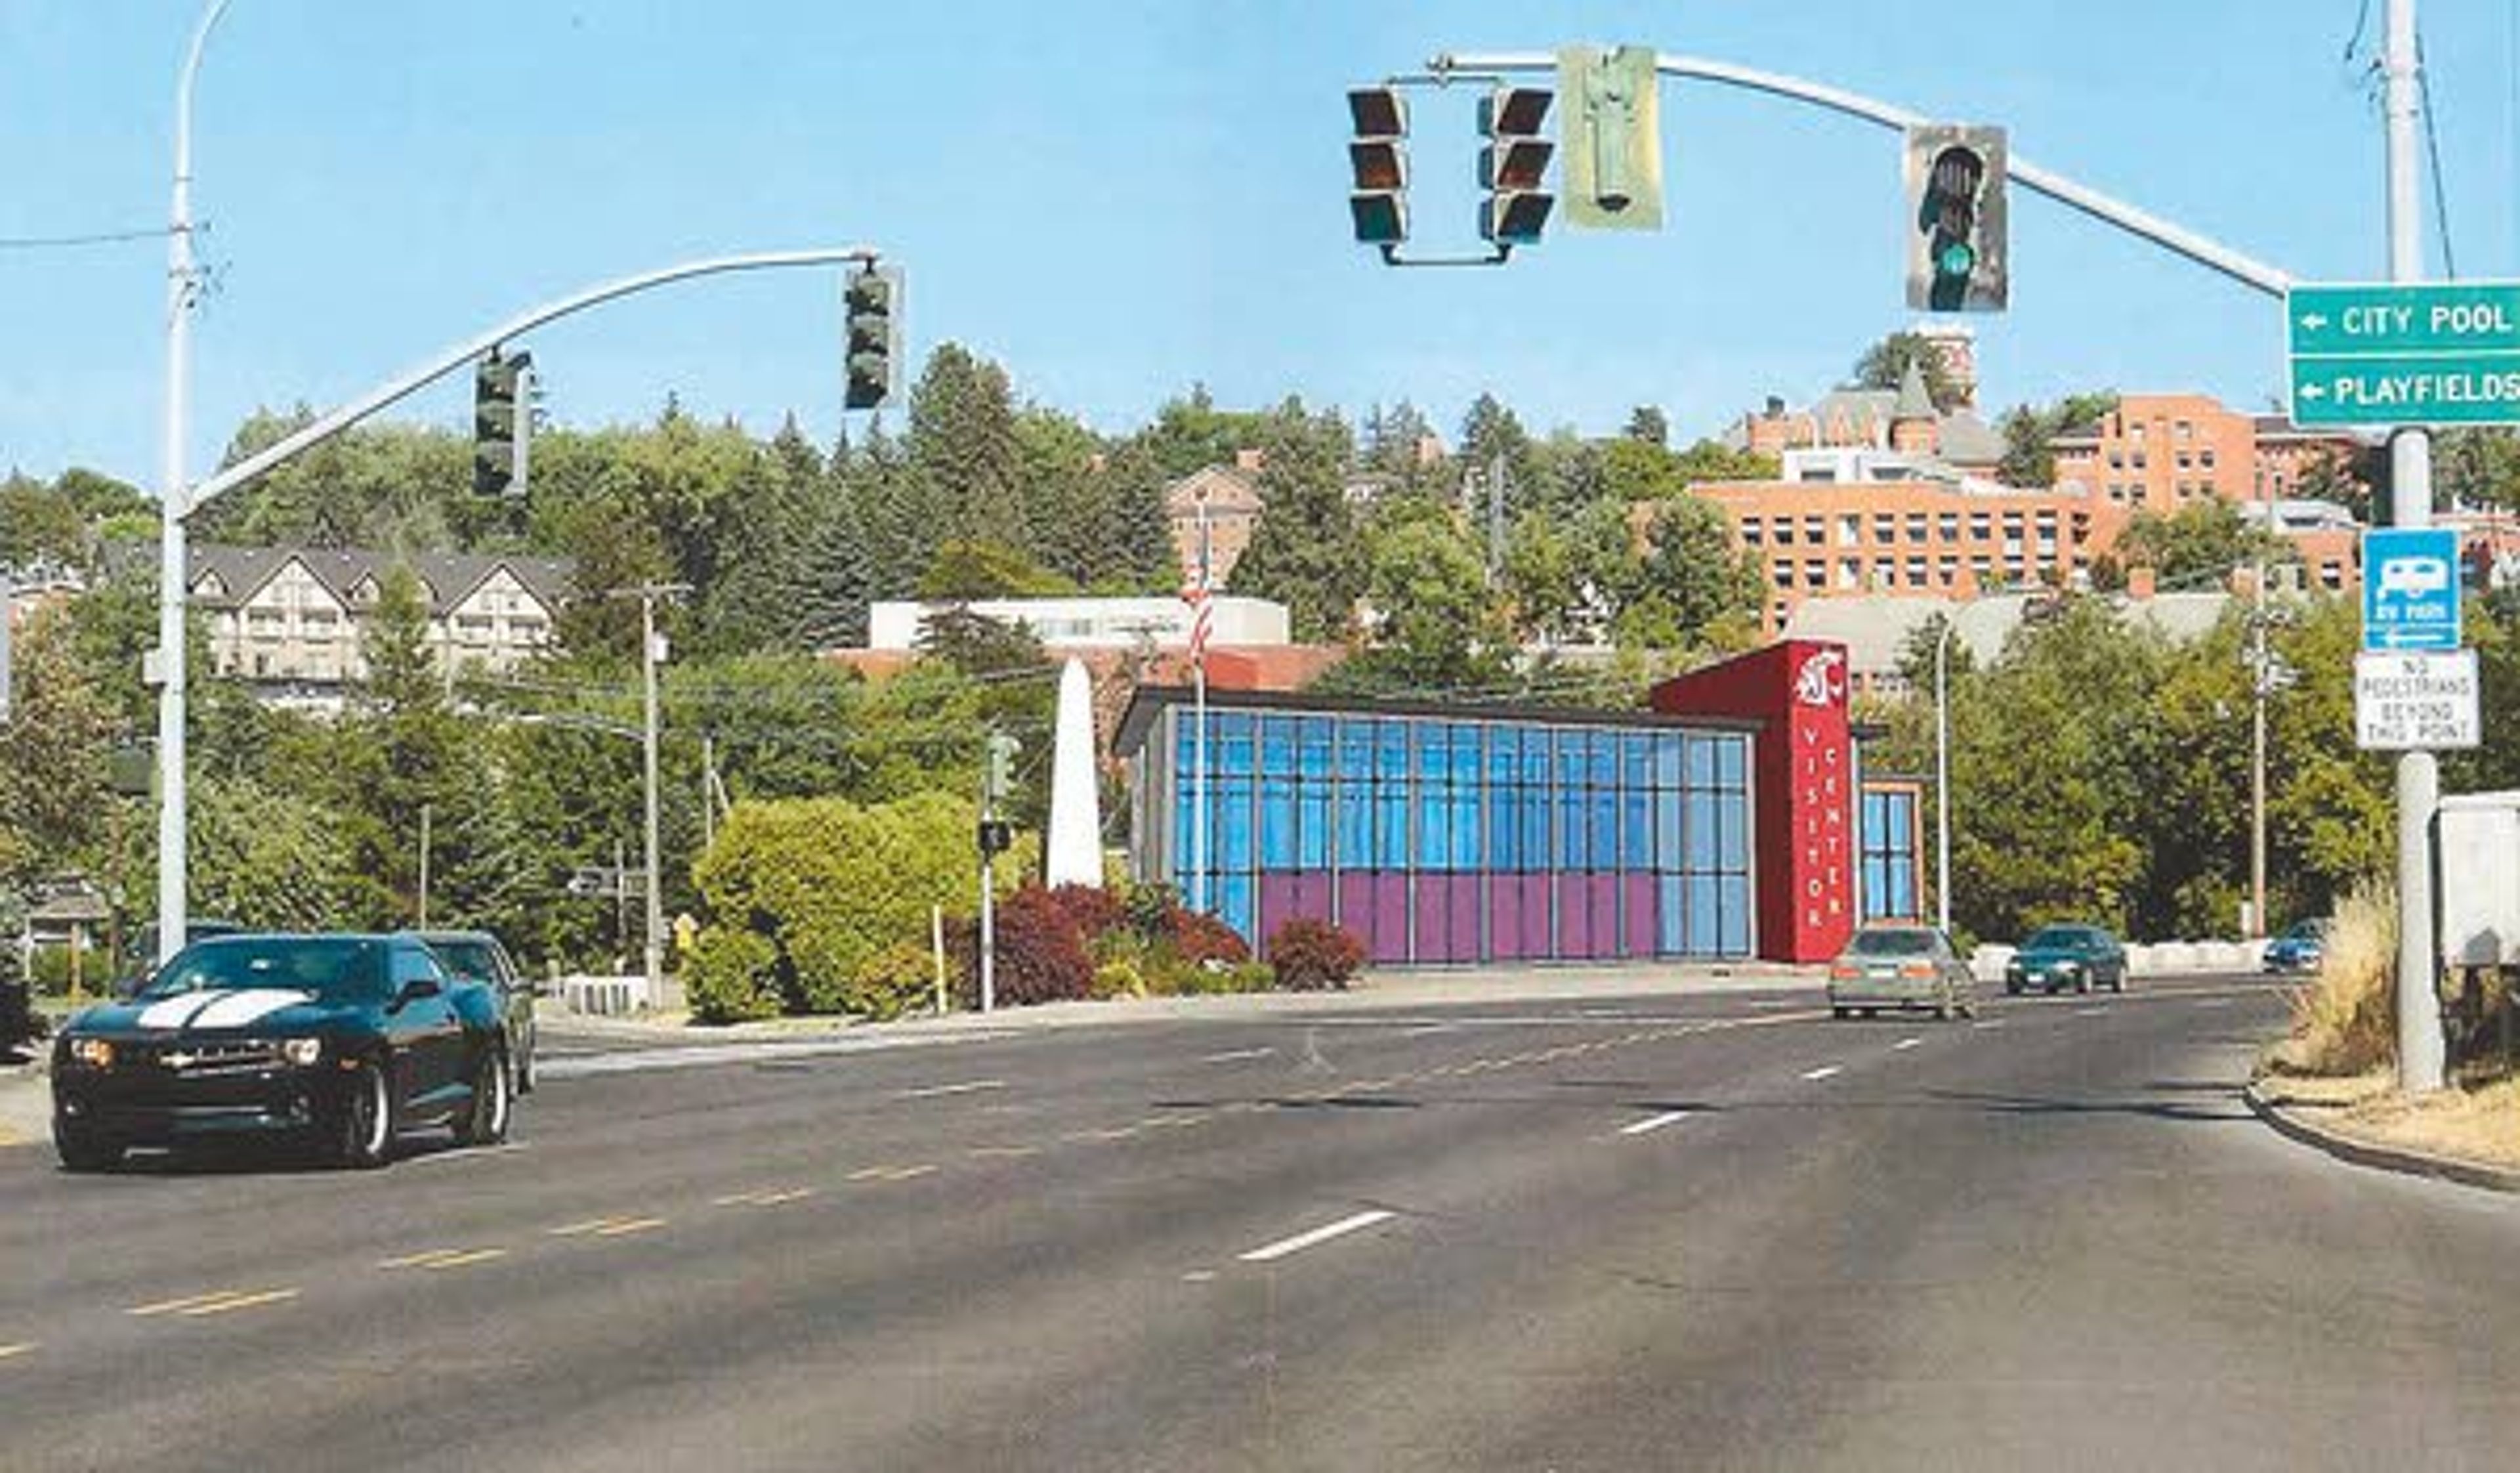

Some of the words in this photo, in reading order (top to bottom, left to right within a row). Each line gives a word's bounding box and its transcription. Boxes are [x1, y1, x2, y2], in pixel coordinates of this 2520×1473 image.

[2343, 306, 2412, 335] CITY
[2431, 303, 2513, 333] POOL
[1804, 728, 1822, 927] VISITOR
[1825, 748, 1840, 914] CENTER
